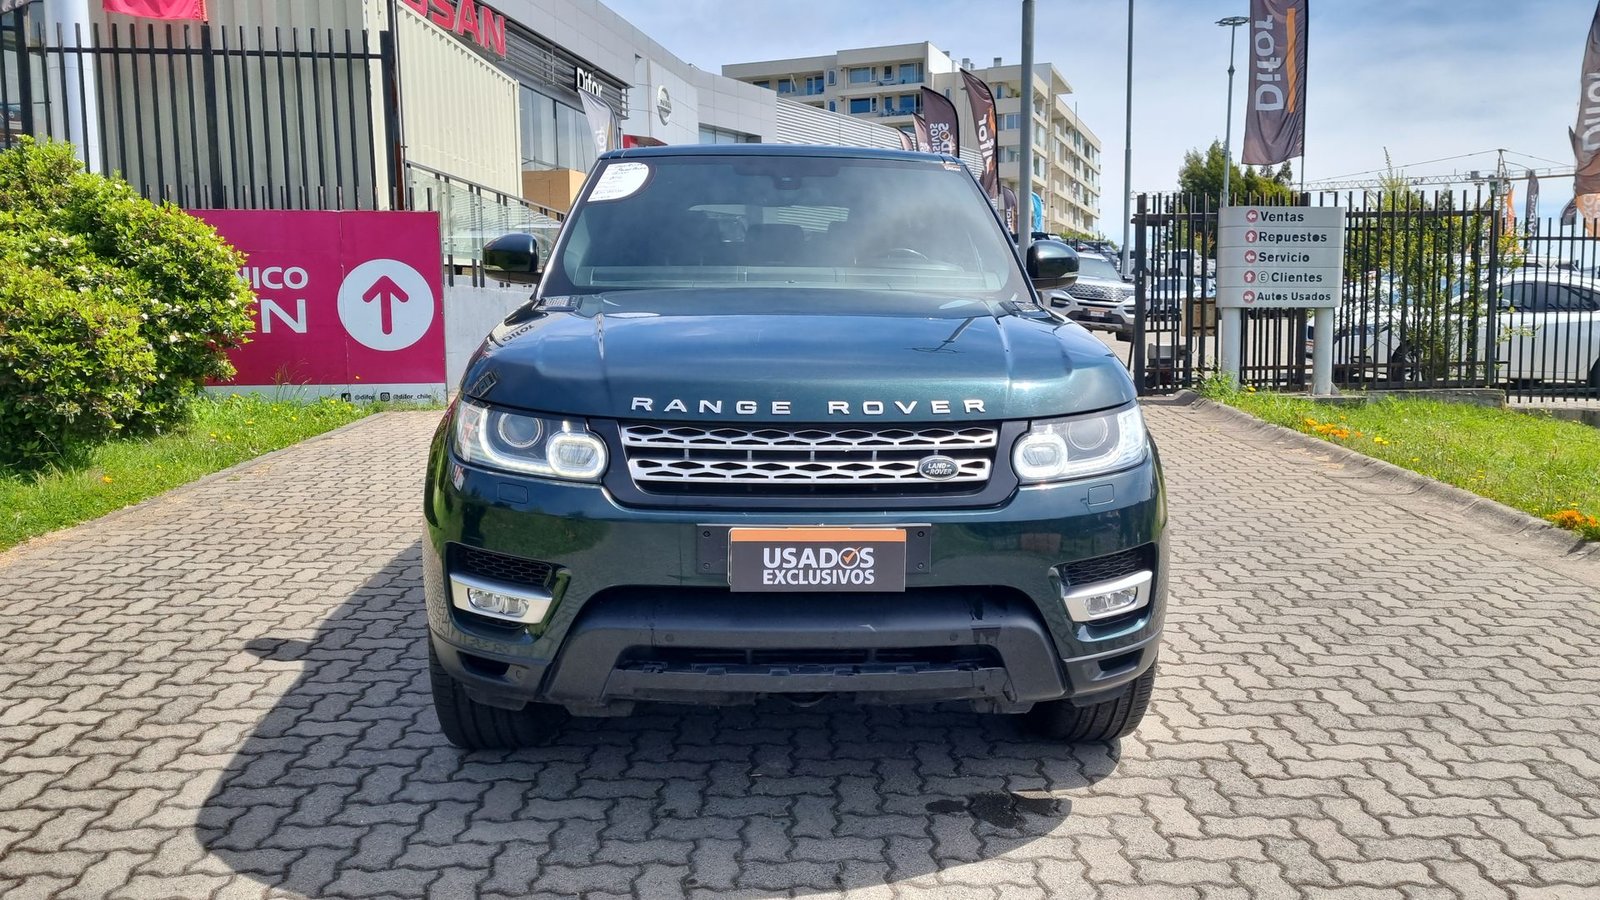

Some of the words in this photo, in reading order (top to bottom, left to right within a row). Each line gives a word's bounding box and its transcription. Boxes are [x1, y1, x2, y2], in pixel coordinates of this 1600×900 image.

[576, 67, 603, 97] Difor
[1260, 211, 1304, 222] Ventas
[1258, 231, 1327, 244] Repuestos
[1258, 252, 1310, 263] Servicio
[1271, 272, 1323, 283] Clientes
[1257, 292, 1288, 301] Autos
[1291, 292, 1331, 301] Usados
[630, 396, 791, 416] RANGE
[827, 398, 987, 416] ROVER
[762, 546, 875, 569] USADOS
[762, 569, 875, 586] EXCLUSIVOS
